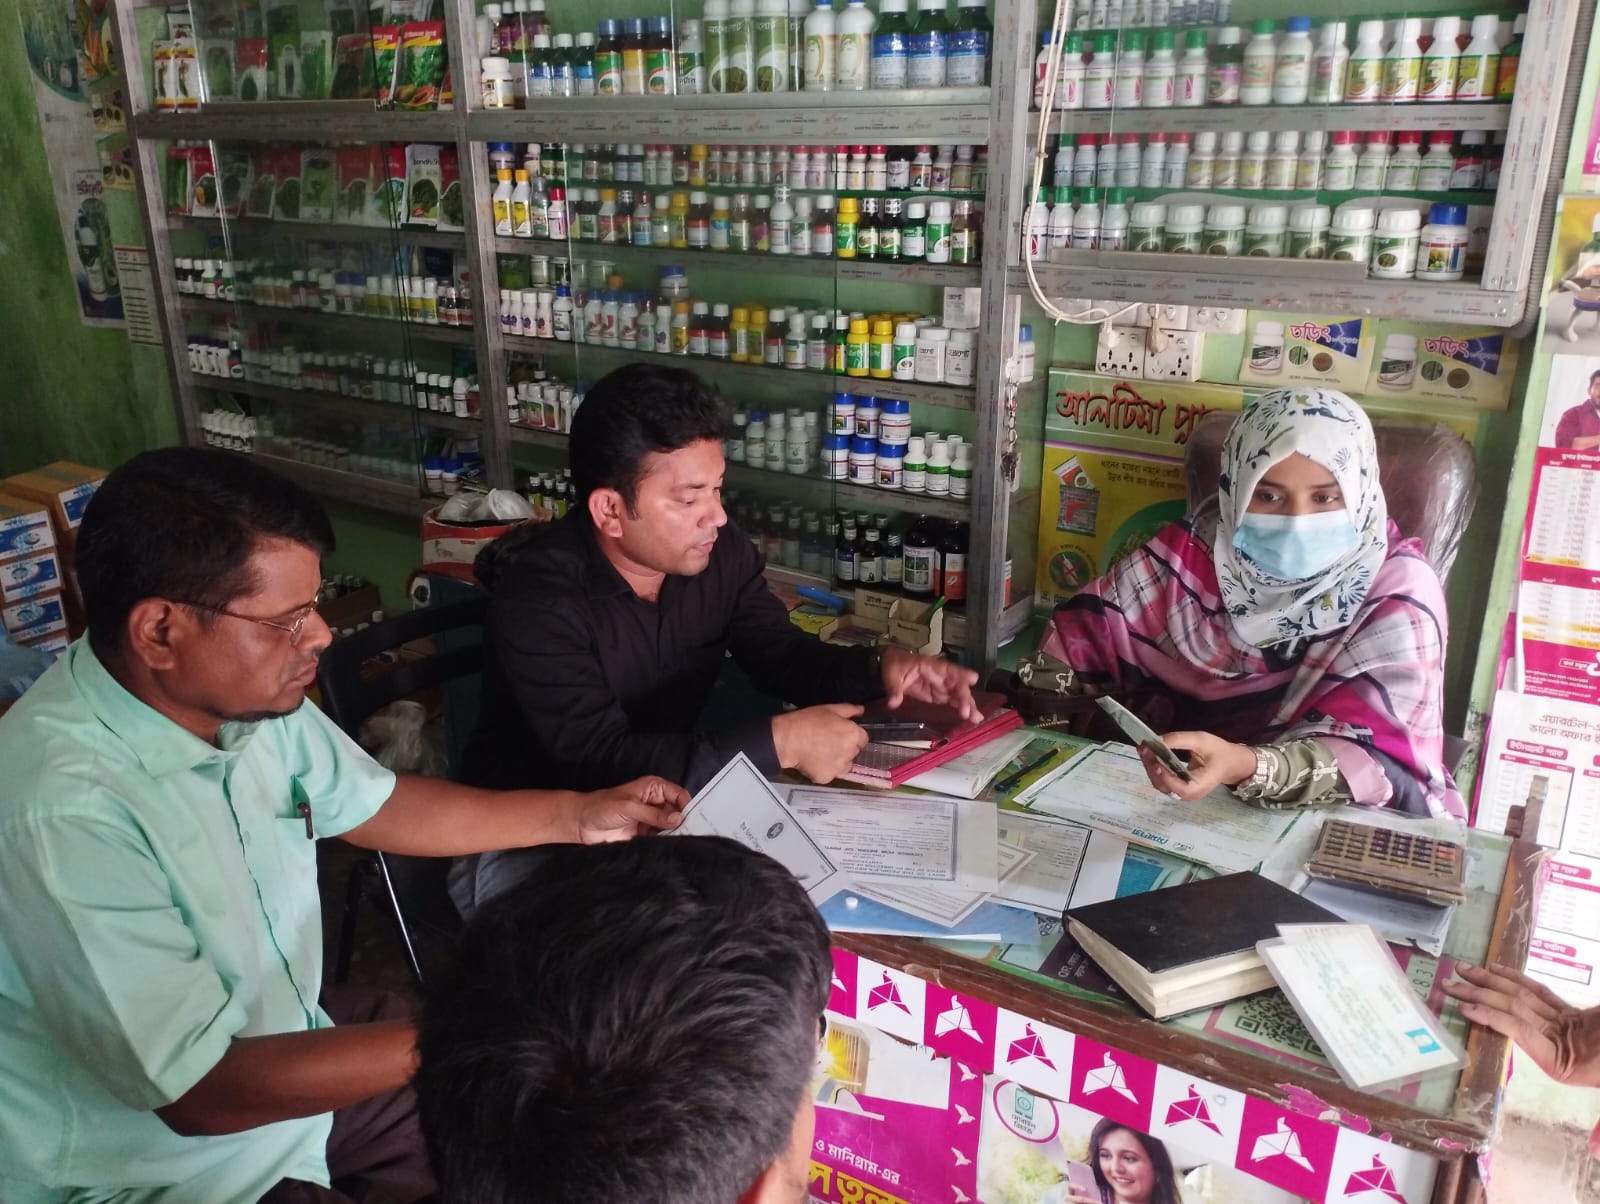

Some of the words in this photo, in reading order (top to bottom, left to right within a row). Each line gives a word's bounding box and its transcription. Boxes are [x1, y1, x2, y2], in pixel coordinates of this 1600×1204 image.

[1289, 321, 1332, 343] তড়িৎ
[1424, 336, 1469, 359] তড়িৎ
[1056, 381, 1166, 435] আলটিমা
[815, 1138, 826, 1151] ও
[828, 1143, 901, 1186] মানিগ্রাম-এর
